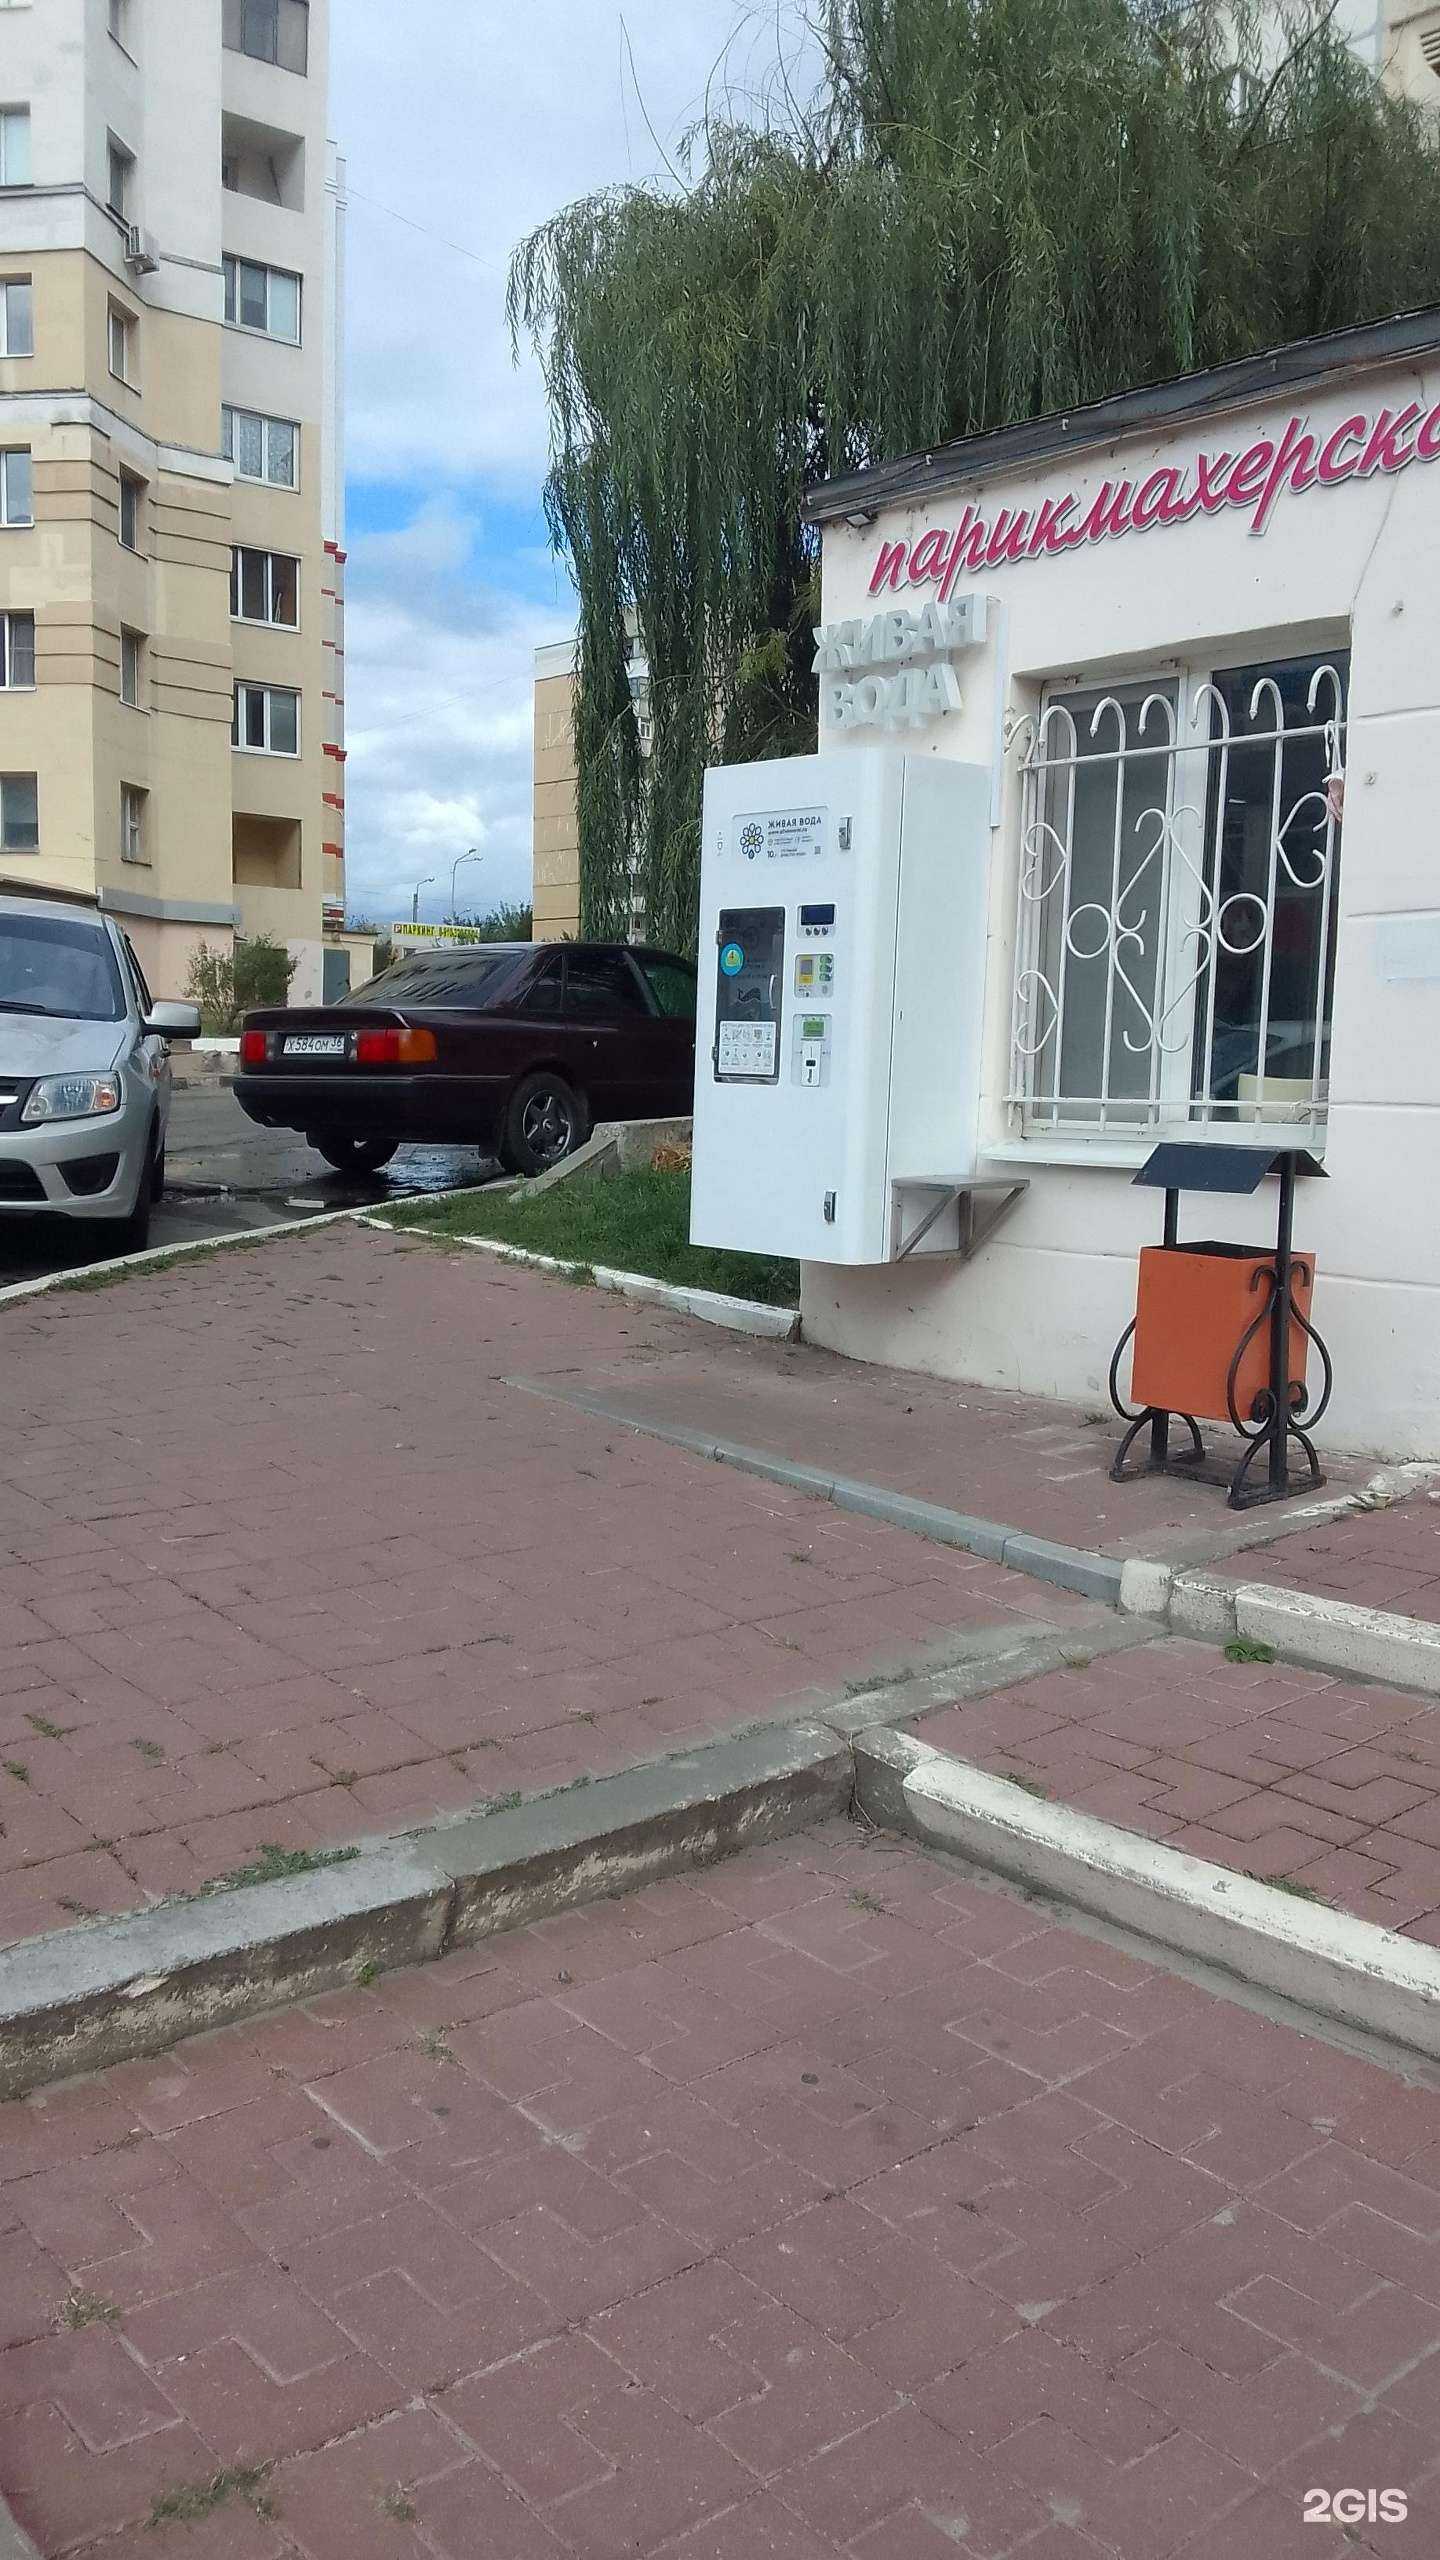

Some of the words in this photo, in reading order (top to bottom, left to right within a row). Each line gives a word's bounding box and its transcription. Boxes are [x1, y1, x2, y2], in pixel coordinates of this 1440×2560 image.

[811, 593, 986, 673] ЖИВАЯ
[825, 663, 962, 729] ВОДА
[767, 818, 797, 829] ЖИВАЯ
[799, 816, 822, 826] ВОДА
[331, 1036, 342, 1047] 36
